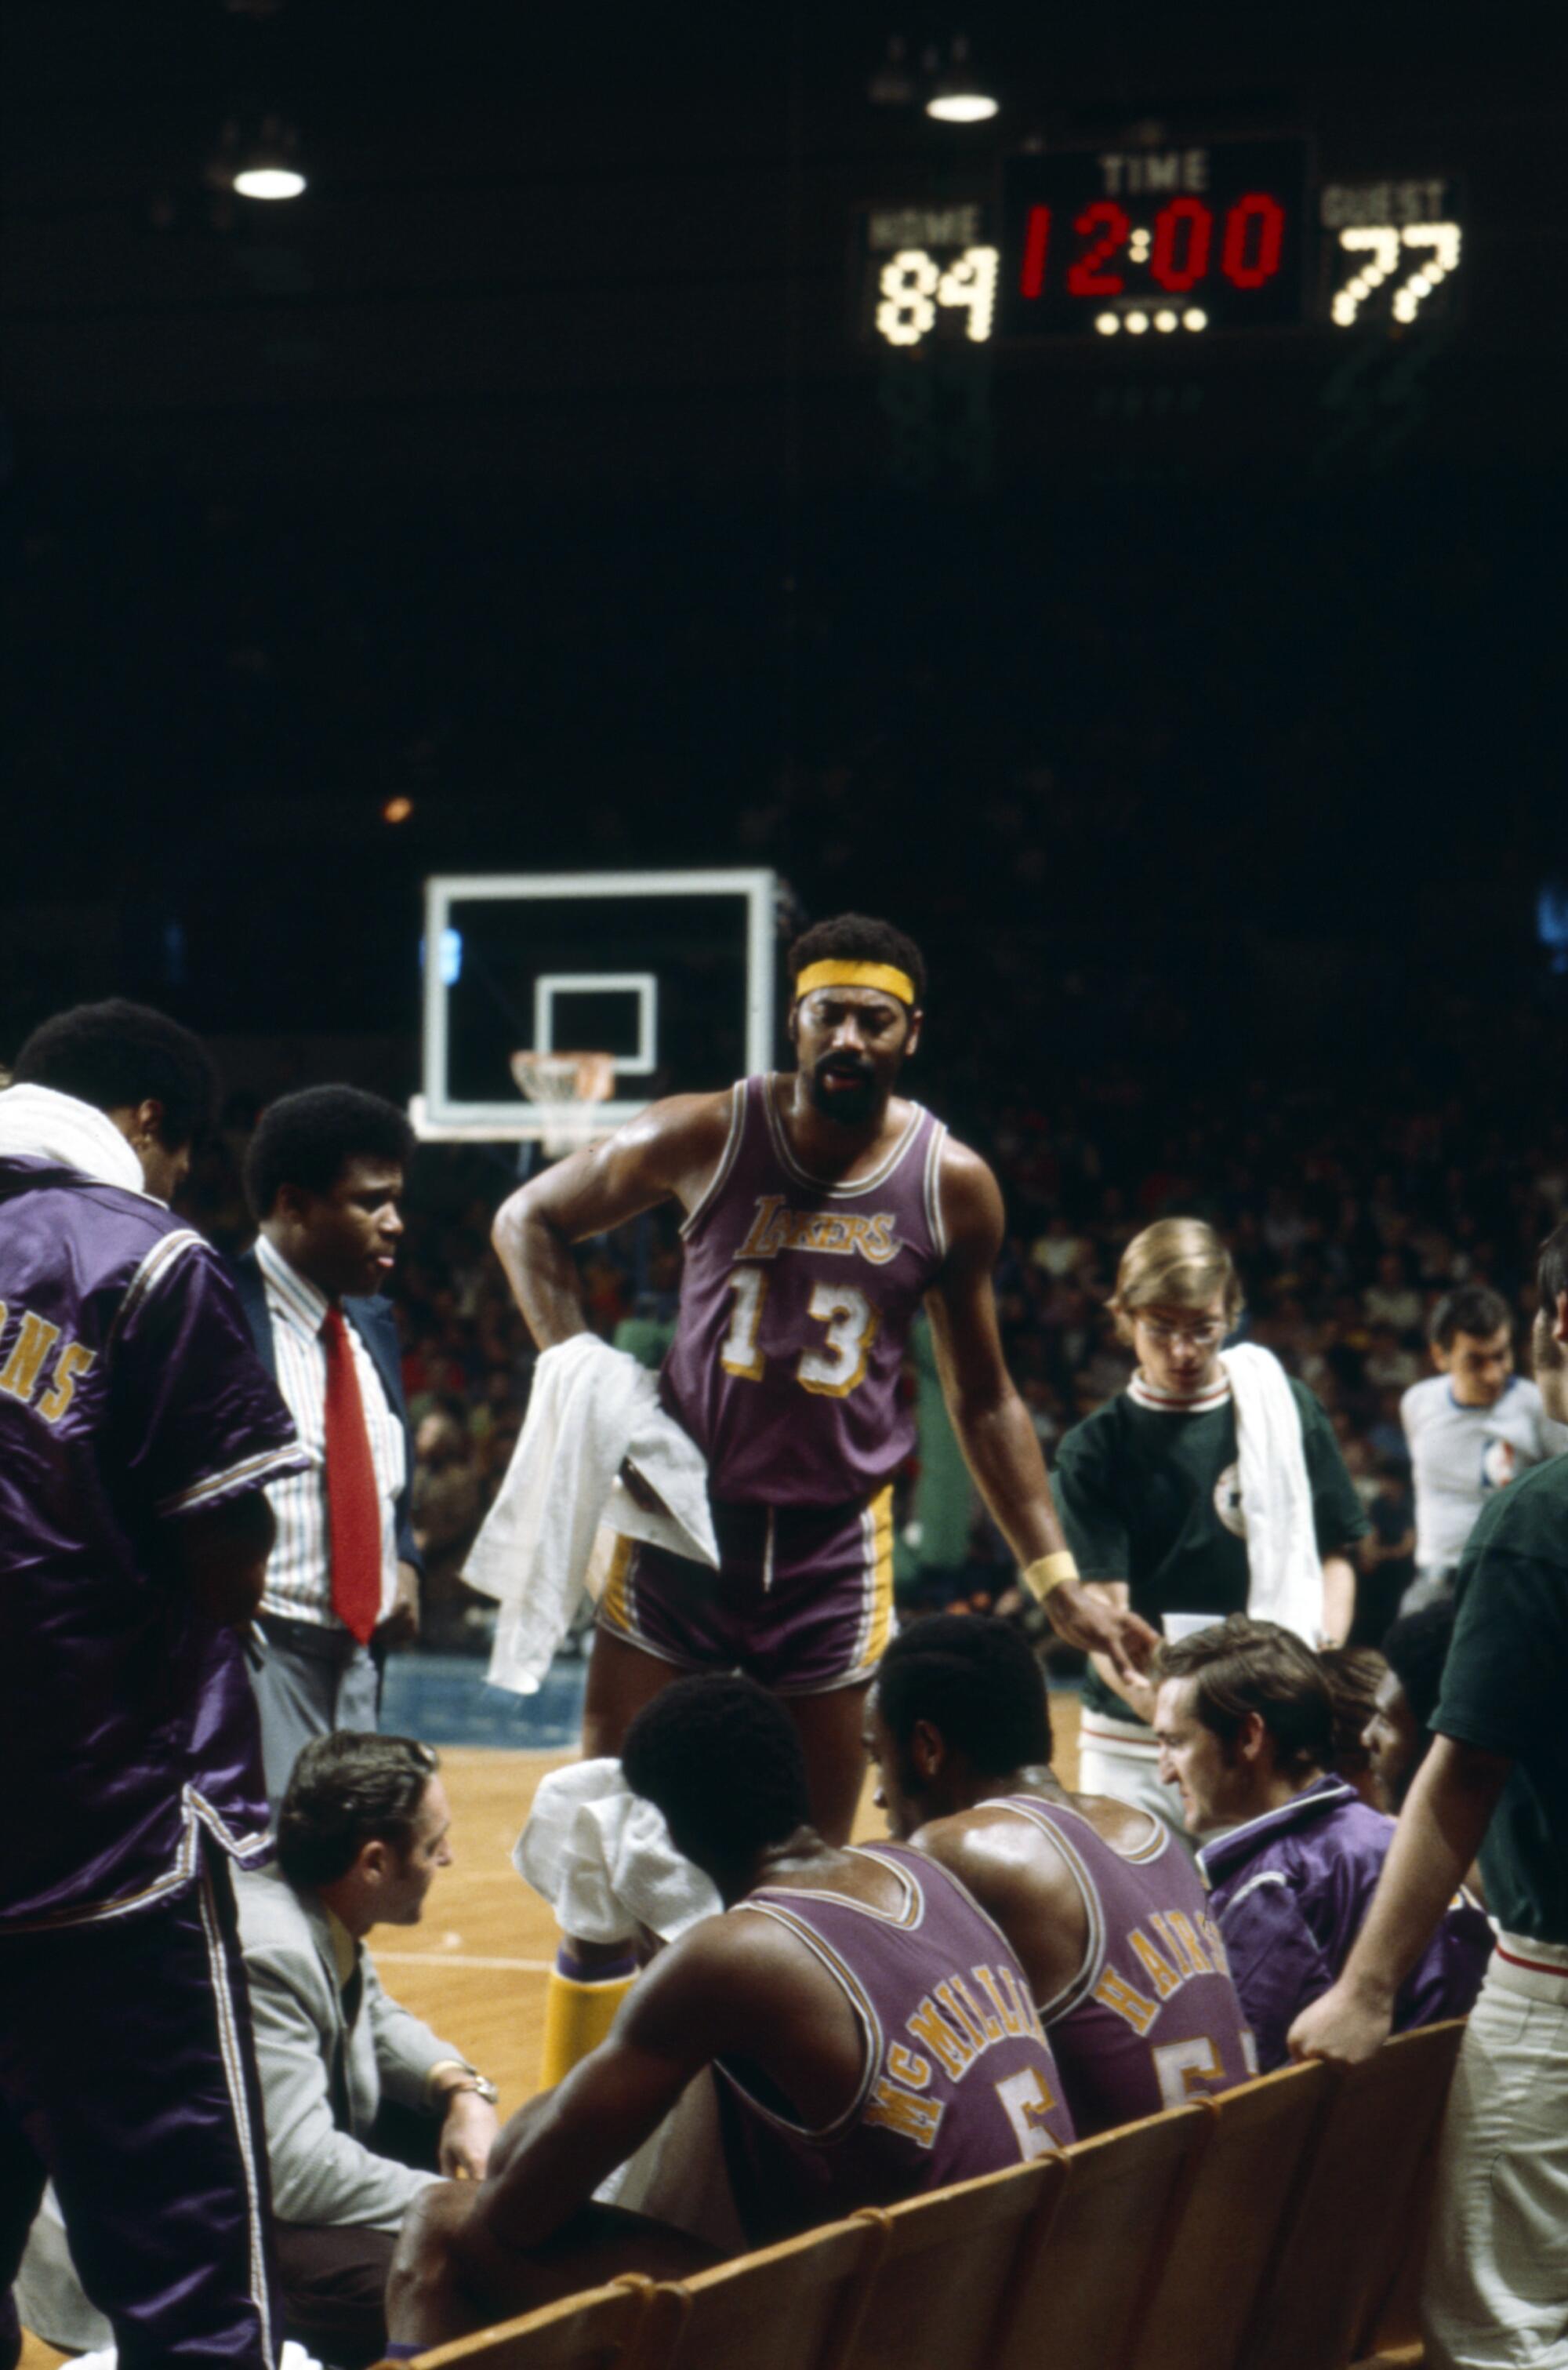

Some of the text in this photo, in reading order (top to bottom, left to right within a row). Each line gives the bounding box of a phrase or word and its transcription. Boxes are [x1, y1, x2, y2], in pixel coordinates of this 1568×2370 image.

[1099, 150, 1210, 195] TIME
[1319, 178, 1447, 227] GUEST
[868, 203, 982, 250] HOME
[1019, 192, 1286, 300] 12:00
[1330, 221, 1462, 327] 77
[875, 245, 1000, 347] 84
[733, 1194, 903, 1266] LAKERS
[0, 1299, 98, 1424] NS
[720, 1266, 881, 1398] 13
